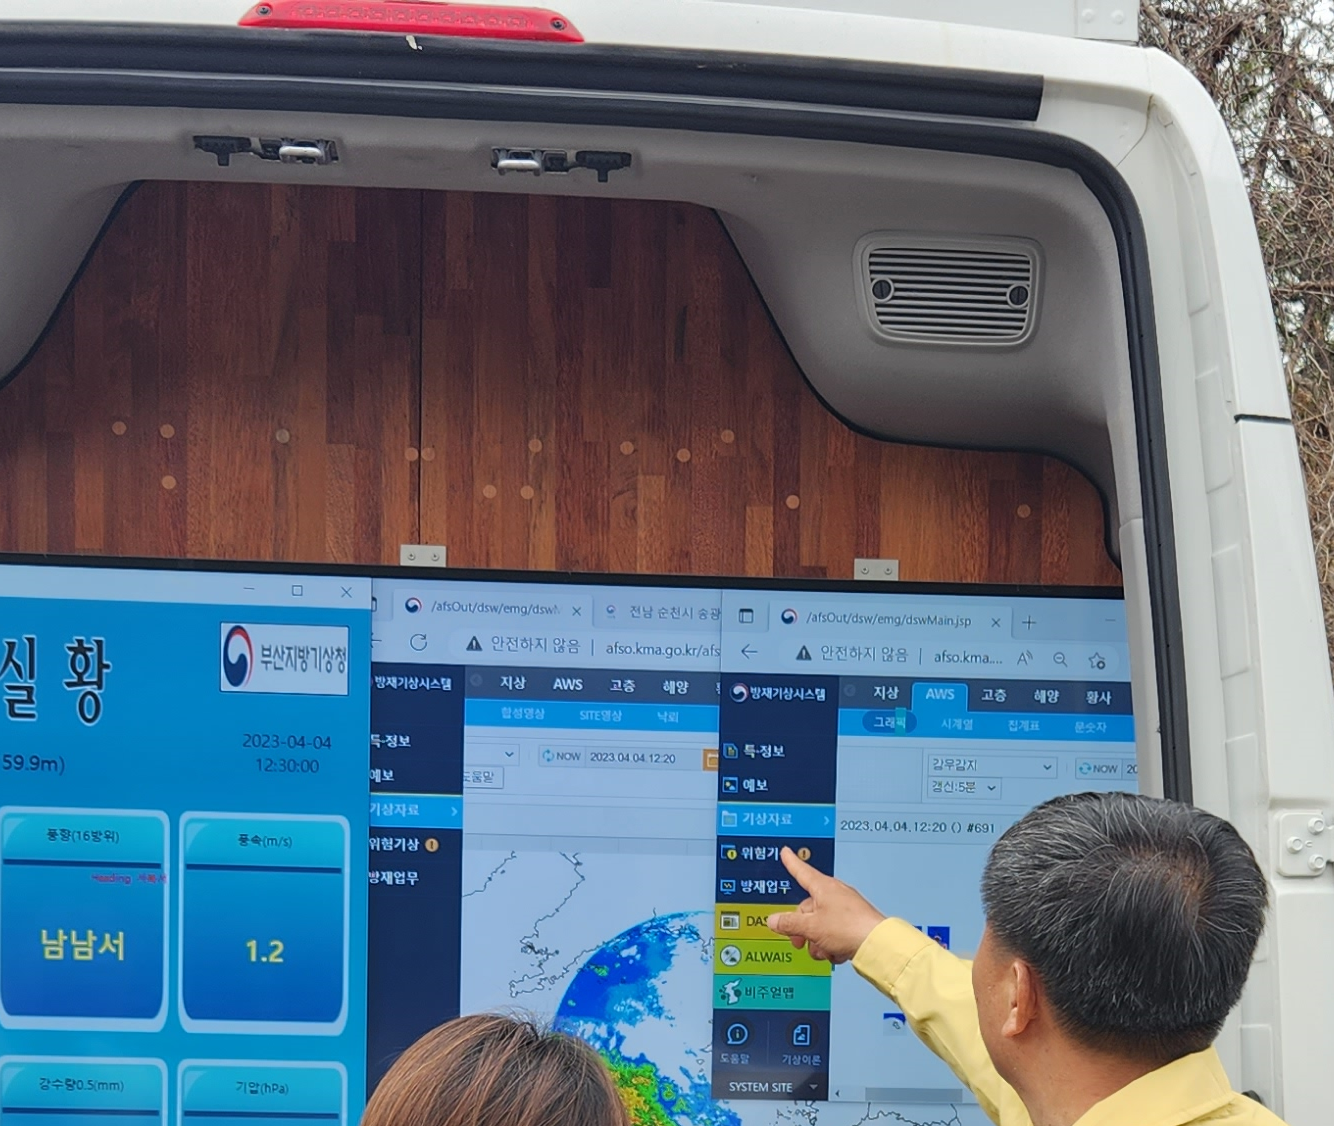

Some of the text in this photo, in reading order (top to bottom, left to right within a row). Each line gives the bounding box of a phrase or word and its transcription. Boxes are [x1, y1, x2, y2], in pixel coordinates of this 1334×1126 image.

[630, 605, 653, 619] 전남
[657, 606, 694, 620] 순천시
[806, 611, 972, 628] /afsOut/dsw/emg/dswMain.jsp
[491, 635, 547, 653] 안전하지
[553, 637, 581, 654] 않음
[260, 644, 347, 674] 부산지방기상청
[821, 645, 876, 662] 안전하지
[881, 646, 909, 663] 않음
[374, 675, 452, 691] 방재기상시스템
[500, 675, 689, 695] 지상 AWS 고층 해양
[750, 687, 826, 701] 방재기상시스템
[873, 686, 1112, 705] 지상 AWS 고층 해양 황사
[873, 716, 906, 729] 그래픽
[941, 718, 974, 731] 시계열
[242, 733, 332, 750] 2023-04-04
[556, 752, 582, 762] NOW
[256, 757, 320, 773] 12:30:00
[1093, 764, 1118, 774] NOW
[369, 769, 395, 782] 예보
[742, 779, 768, 792] 예보
[932, 781, 976, 793] 갱신:5분
[370, 803, 419, 817] 기상자료
[742, 812, 792, 826] 기상자료
[840, 819, 947, 834] 2023.04.04.12:20
[967, 822, 995, 834] #691
[46, 828, 120, 844] 풍향(16방위)
[238, 833, 293, 848] 풍속(m/s)
[369, 838, 419, 852] 위험기상
[742, 847, 782, 860] 위험기
[368, 871, 419, 885] 방재업무
[741, 880, 791, 894] 방재업무
[40, 928, 125, 961] 남남서
[245, 939, 285, 963] 1.2
[744, 951, 792, 964] ALWAIS
[745, 986, 794, 1000] 비주얼맵
[720, 1053, 750, 1065] 도움말
[782, 1054, 822, 1066] 기상이론
[39, 1077, 125, 1092] 강수량0.5(mm)
[236, 1081, 289, 1096] 기압(hPa)
[729, 1081, 793, 1093] SYSTEM SITE
